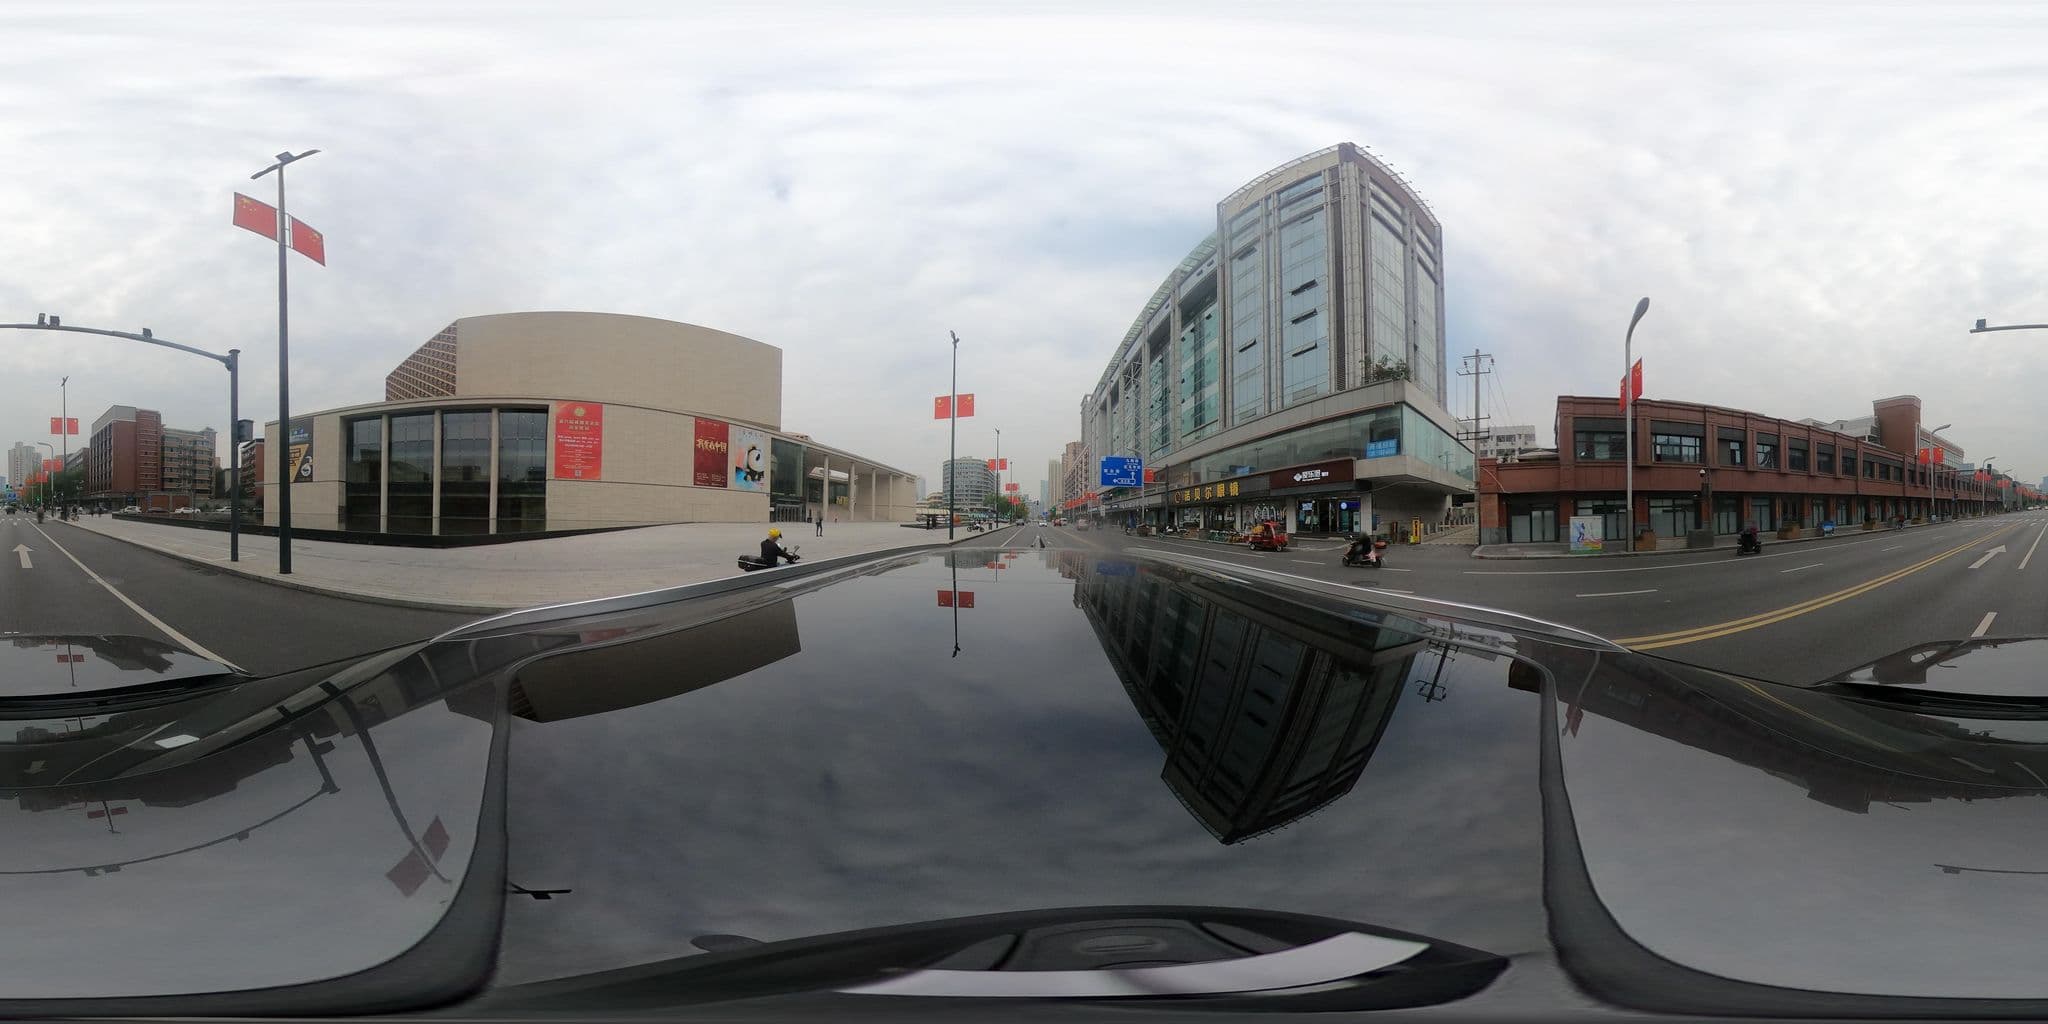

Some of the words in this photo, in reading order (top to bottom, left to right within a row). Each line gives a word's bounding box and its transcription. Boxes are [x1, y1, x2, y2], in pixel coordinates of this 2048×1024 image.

[1184, 481, 1239, 502] 诺贝尔眼镜
